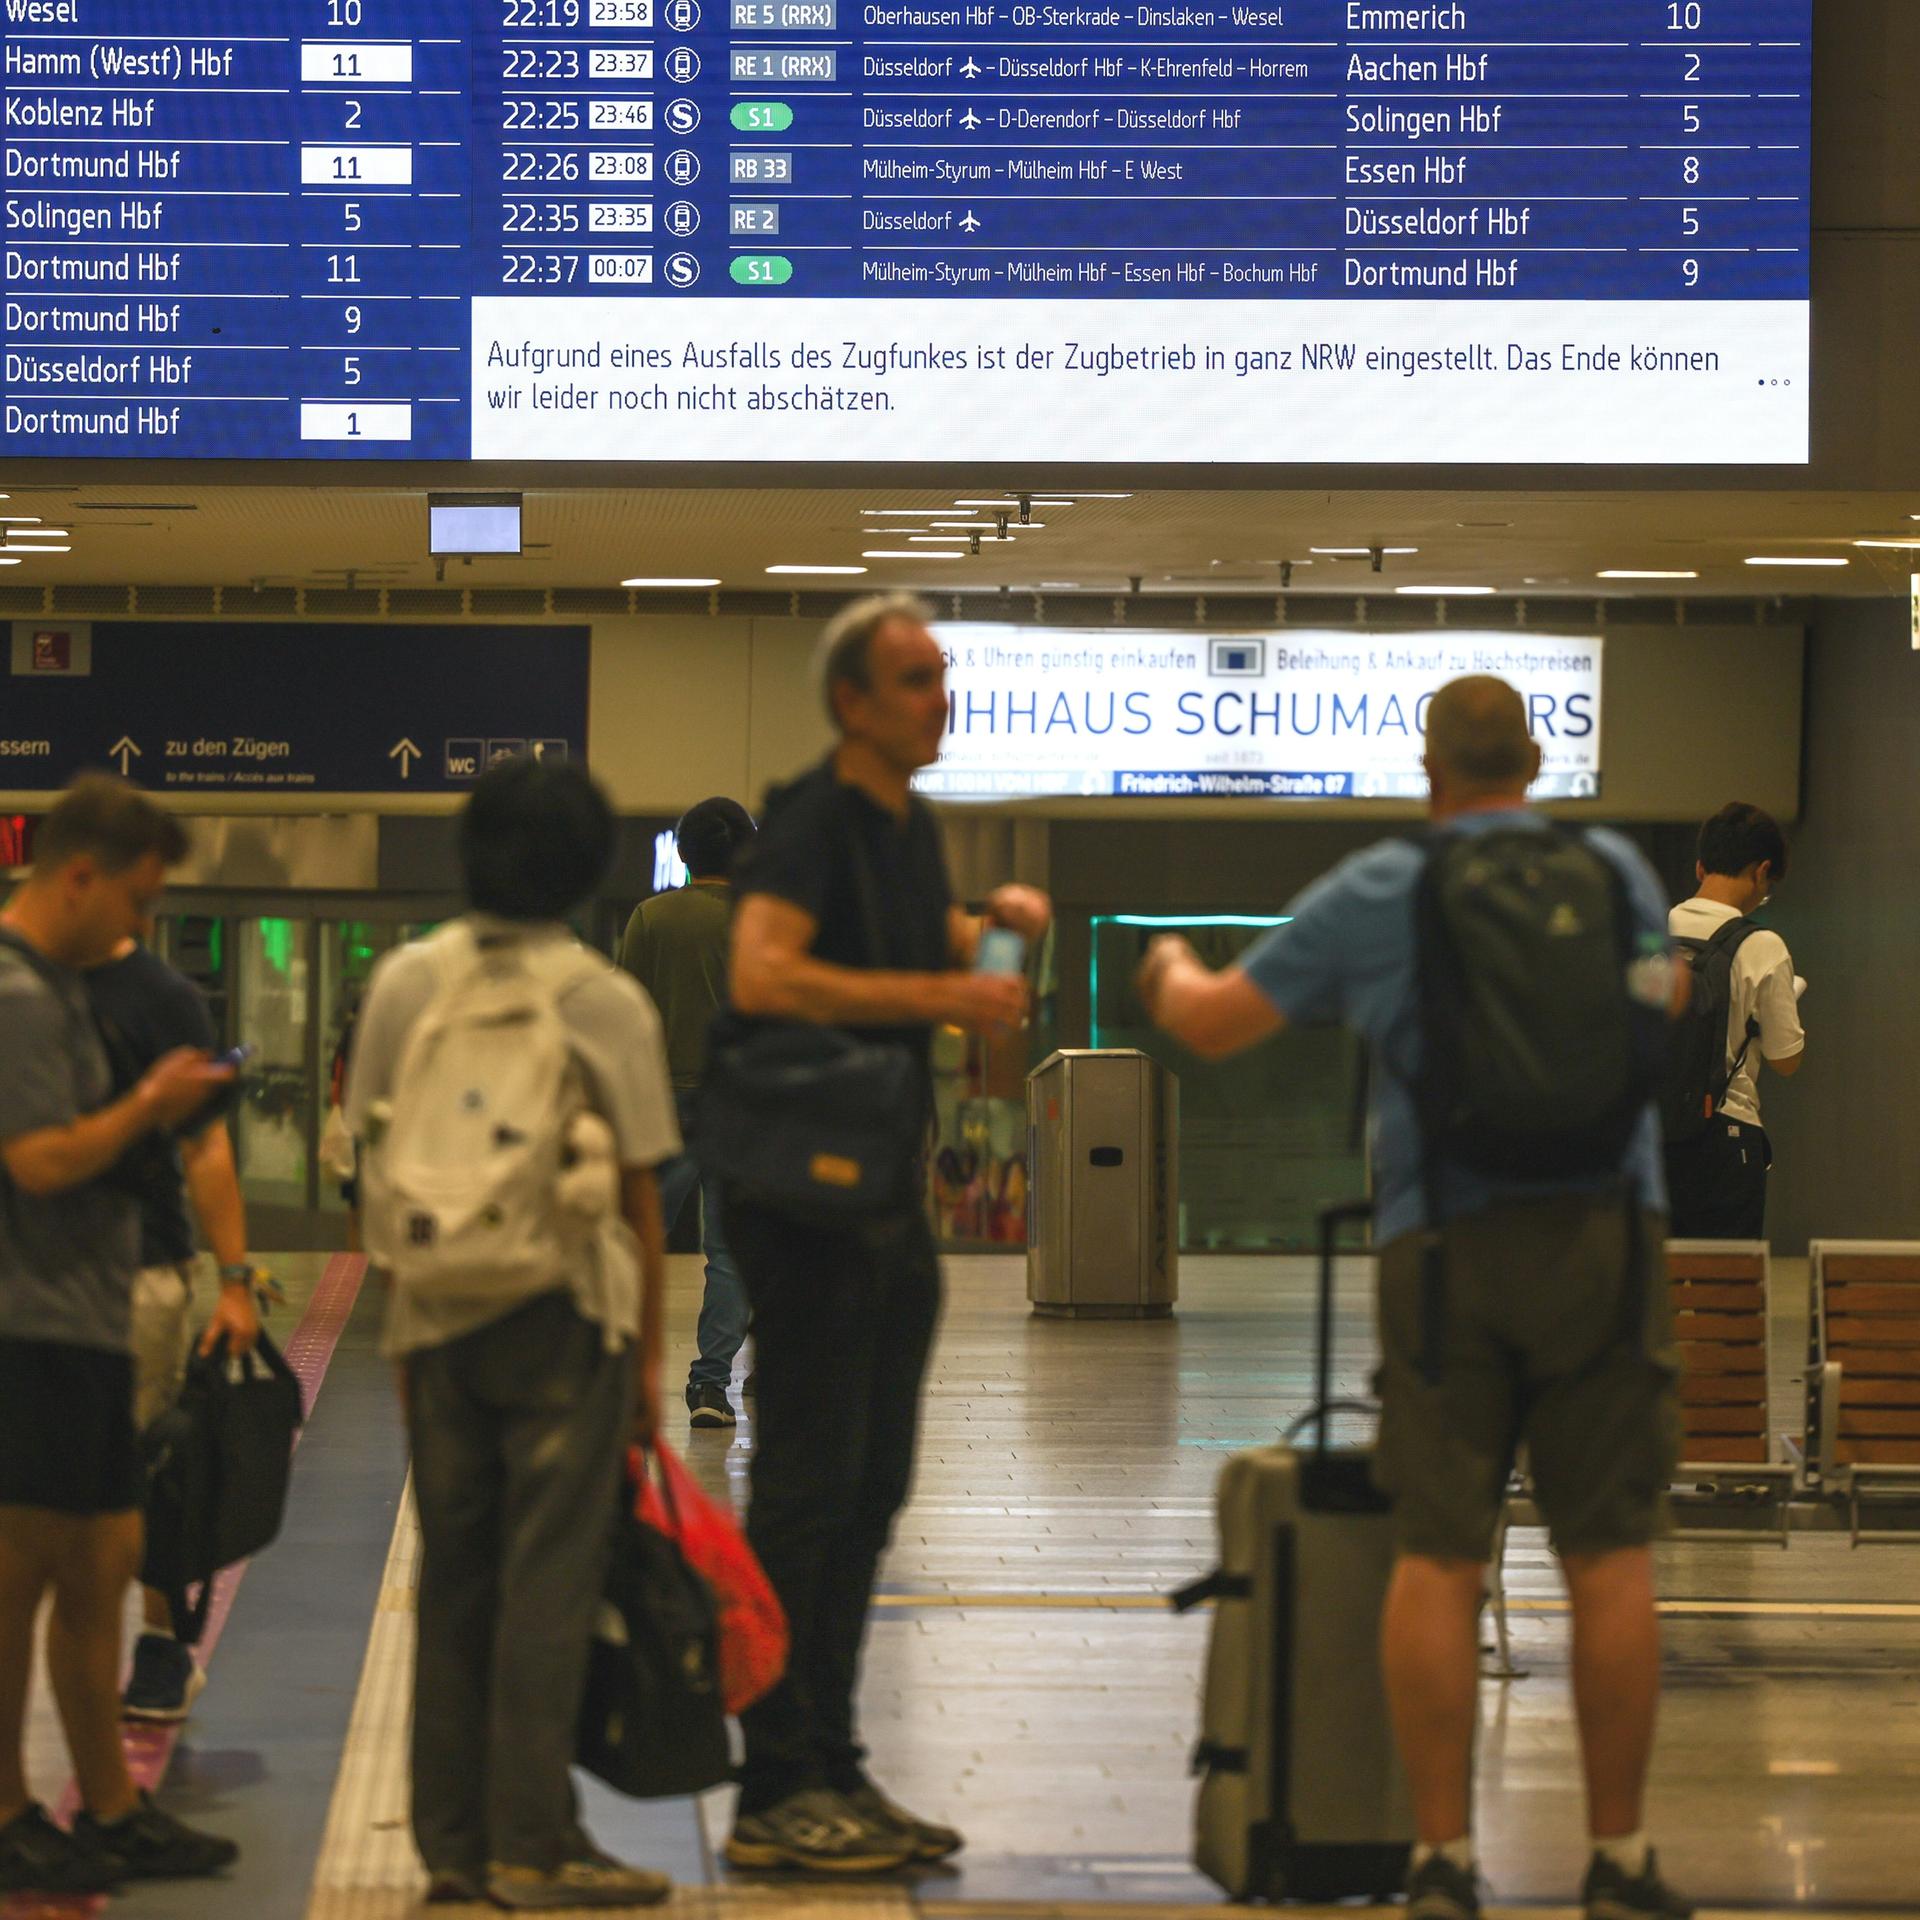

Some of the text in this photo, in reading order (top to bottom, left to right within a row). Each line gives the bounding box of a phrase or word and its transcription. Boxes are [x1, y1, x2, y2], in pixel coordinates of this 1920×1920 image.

[5, 0, 78, 23] Wesel
[327, 0, 362, 26] 10
[502, 0, 580, 27] 22:19
[595, 2, 648, 21] 23:58
[735, 4, 831, 27] RE 5 (RRX)
[864, 5, 1284, 26] Oberhausen Hbf OB-Sterkrade Dinslaken Wesel
[1347, 1, 1465, 30] Emmerich
[1667, 2, 1701, 30] 10
[5, 43, 233, 80] Hamm (Westf) Hbf
[333, 53, 362, 77] 11
[502, 49, 580, 79] 22:23
[595, 53, 647, 72] 23:37
[735, 55, 831, 78] RE 1 (RRX)
[863, 56, 1308, 78] Düsseldorf Düsseldorf Hbf K-Ehrenfeld Horrem
[1346, 53, 1488, 81] Aachen Hbf
[1684, 53, 1700, 81] 2
[5, 96, 155, 127] Koblenz Hbf
[345, 100, 361, 129] 2
[502, 101, 579, 130] 22:25
[595, 104, 647, 124] 23:46
[749, 107, 773, 127] S1
[863, 107, 1242, 129] Düsseldorf D-Derendorf Düsseldorf Hbf
[1346, 104, 1502, 139] Solingen Hbf
[1683, 104, 1700, 133] 5
[6, 148, 181, 179] Dortmund Hbf
[333, 156, 362, 179] 11
[502, 152, 579, 181] 22:26
[595, 156, 647, 175] 23:08
[735, 159, 787, 178] RB 33
[863, 159, 1183, 184] Mülheim-Styrum Mülheim Hbf E West
[1345, 155, 1467, 184] Essen Hbf
[1683, 156, 1700, 184] 8
[6, 200, 163, 236] Solingen Hbf
[345, 203, 361, 232] 5
[502, 203, 579, 232] 22:35
[594, 207, 647, 226] 23:35
[734, 210, 774, 229] RE 2
[863, 210, 952, 230] Düsseldorf
[1345, 207, 1530, 235] Düsseldorf Hbf
[1682, 207, 1699, 235] 5
[6, 251, 180, 281] Dortmund Hbf
[327, 254, 361, 283] 11
[502, 255, 579, 283] 22:37
[594, 258, 647, 277] 00:07
[749, 261, 773, 280] S1
[863, 261, 1318, 286] Mülheim-Styrum Mülheim Hbf Essen Hbf Bochum Hbf
[1345, 258, 1518, 286] Dortmund Hbf
[1682, 258, 1699, 287] 9
[6, 302, 180, 332] Dortmund Hbf
[344, 305, 361, 334] 9
[6, 354, 192, 384] Düsseldorf Hbf
[344, 357, 361, 385] 5
[487, 340, 1719, 375] Aufgrund eines Ausfalls des Zugfunkes ist der Zugbetrieb in ganz NRW eingestellt. Das Ende können
[487, 382, 895, 411] wir leider noch nicht abschätzen.
[6, 405, 180, 435] Dortmund Hbf
[347, 412, 361, 436] 1
[984, 648, 1034, 669] Uhren
[1040, 648, 1104, 674] günstig
[1111, 650, 1196, 670] einkaufen
[1277, 649, 1361, 673] Beleihung
[1385, 652, 1444, 671] Ankauf
[949, 689, 1151, 735] IHHAUS
[165, 736, 290, 761] zu den Zügen
[448, 757, 476, 774] WC
[1120, 773, 1322, 795] Friedrich-Wilhelm-Straße
